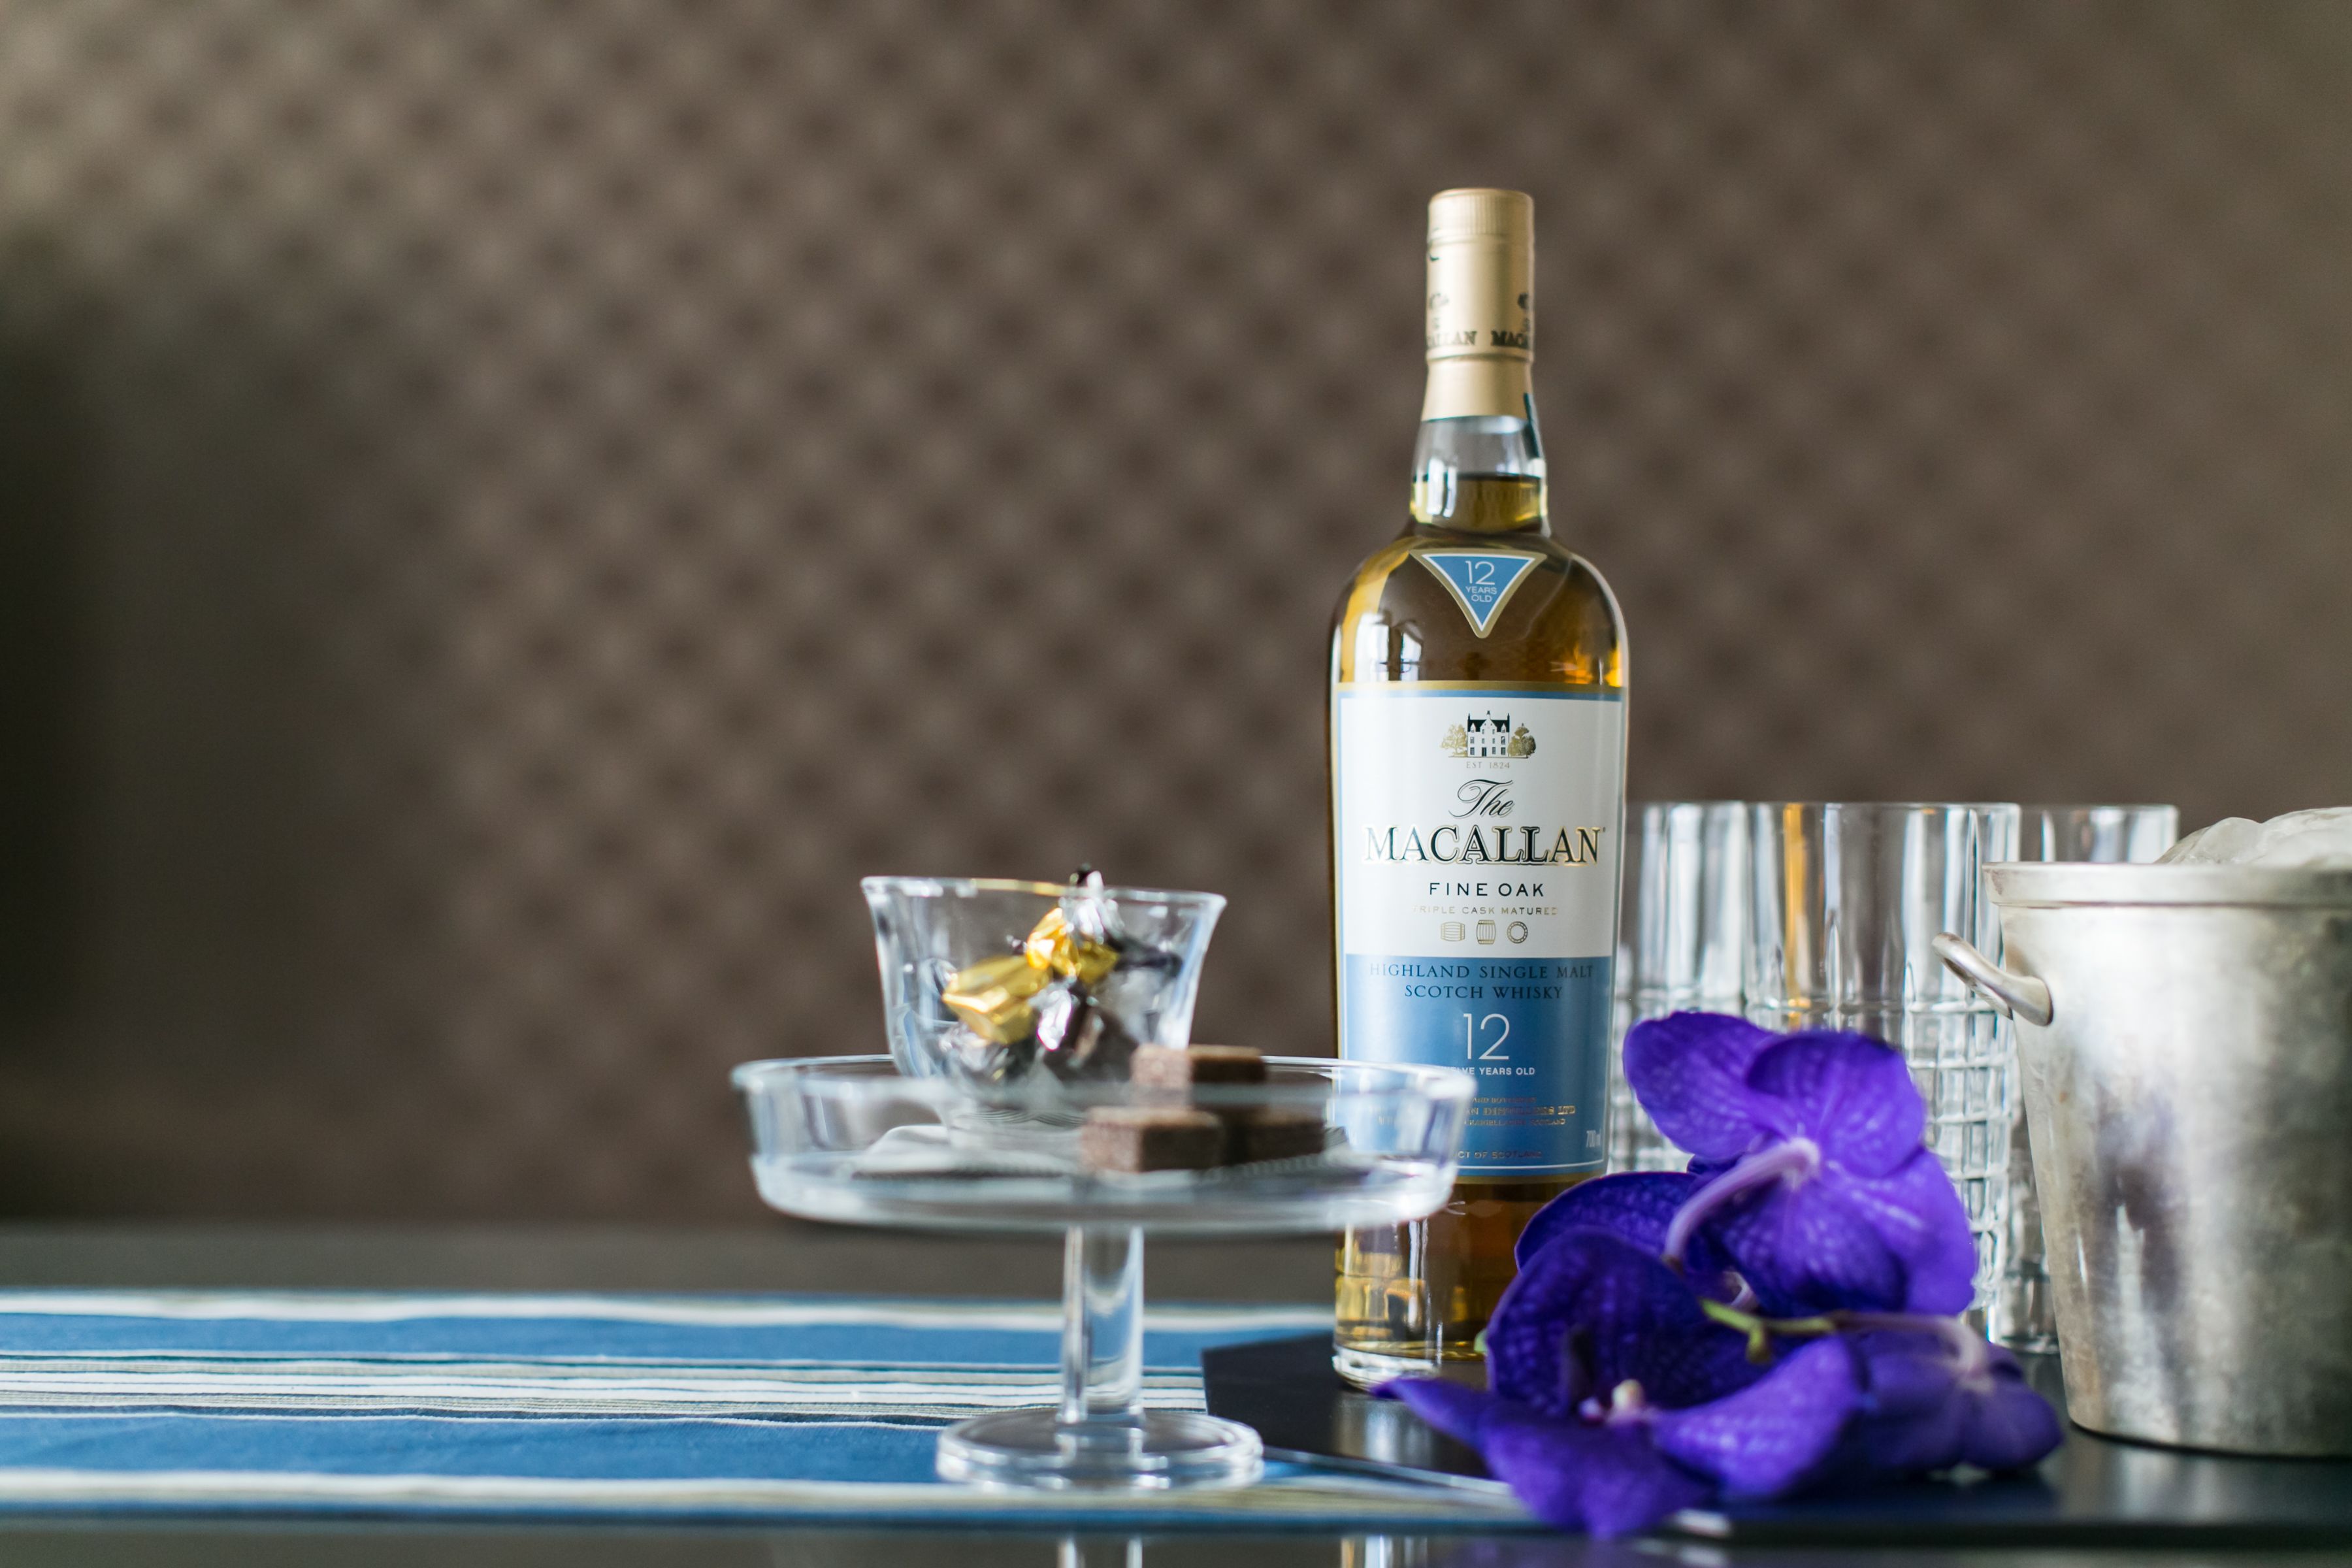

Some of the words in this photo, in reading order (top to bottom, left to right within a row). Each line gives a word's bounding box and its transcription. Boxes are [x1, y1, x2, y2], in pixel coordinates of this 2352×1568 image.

[1465, 561, 1495, 585] 12
[1465, 586, 1497, 595] YEARS
[1448, 779, 1515, 818] The
[1363, 825, 1601, 866] MACALLAN
[1429, 883, 1488, 896] FINE
[1498, 883, 1544, 897] OAK
[1413, 906, 1455, 914] TRIPLE
[1462, 906, 1495, 915] CASK
[1501, 907, 1558, 915] MATURED
[1370, 964, 1470, 979] HIGHLAND
[1479, 966, 1548, 979] SINGLE
[1556, 965, 1593, 979] MALT
[1405, 985, 1484, 999] SCOTCH
[1492, 986, 1563, 999] WHISKY
[1463, 1013, 1510, 1060] 12
[1475, 1151, 1488, 1159] OF
